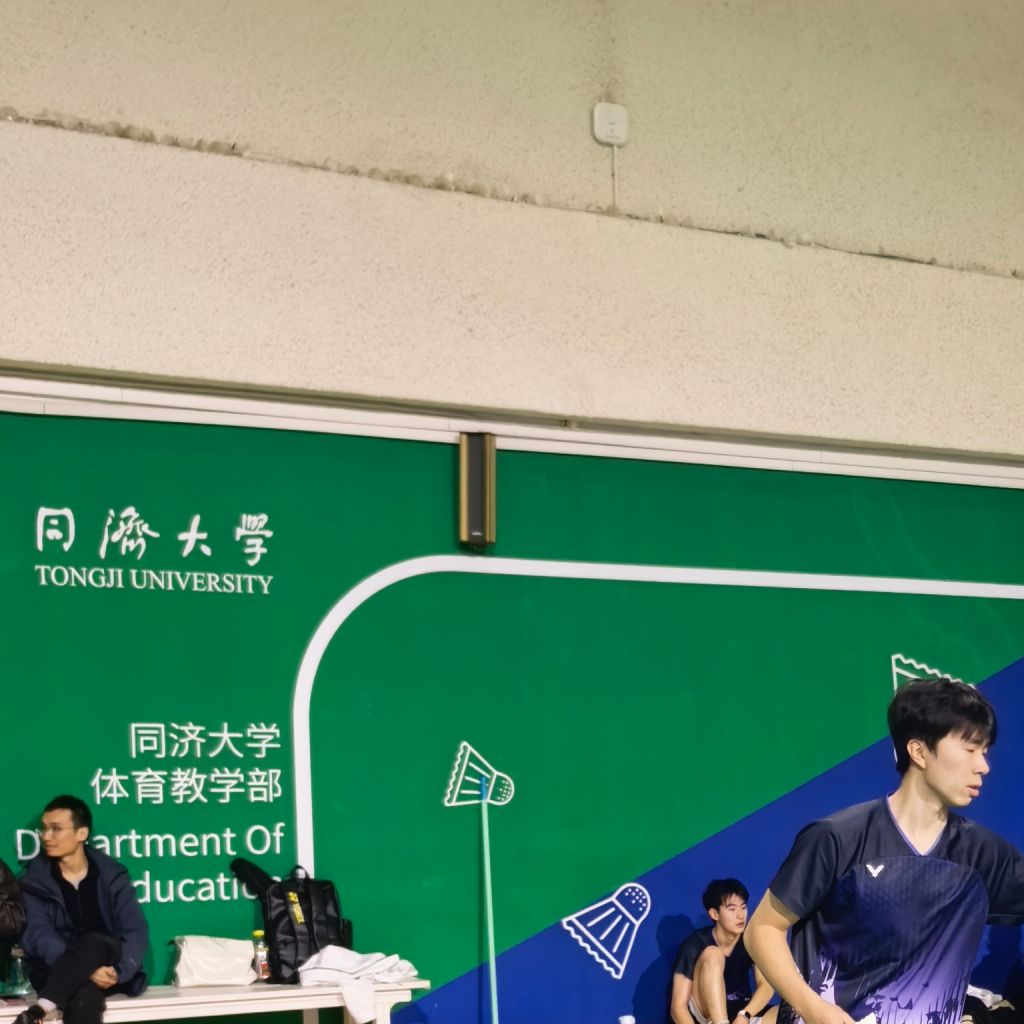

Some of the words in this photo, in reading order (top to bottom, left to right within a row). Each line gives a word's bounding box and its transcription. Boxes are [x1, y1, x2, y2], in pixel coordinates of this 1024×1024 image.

[35, 564, 124, 590] TONGJI
[130, 568, 274, 595] UNIVERSITY
[129, 721, 281, 759] 同济大学
[90, 767, 282, 805] 体育教学部
[15, 827, 237, 861] Dartment
[245, 822, 286, 855] Of
